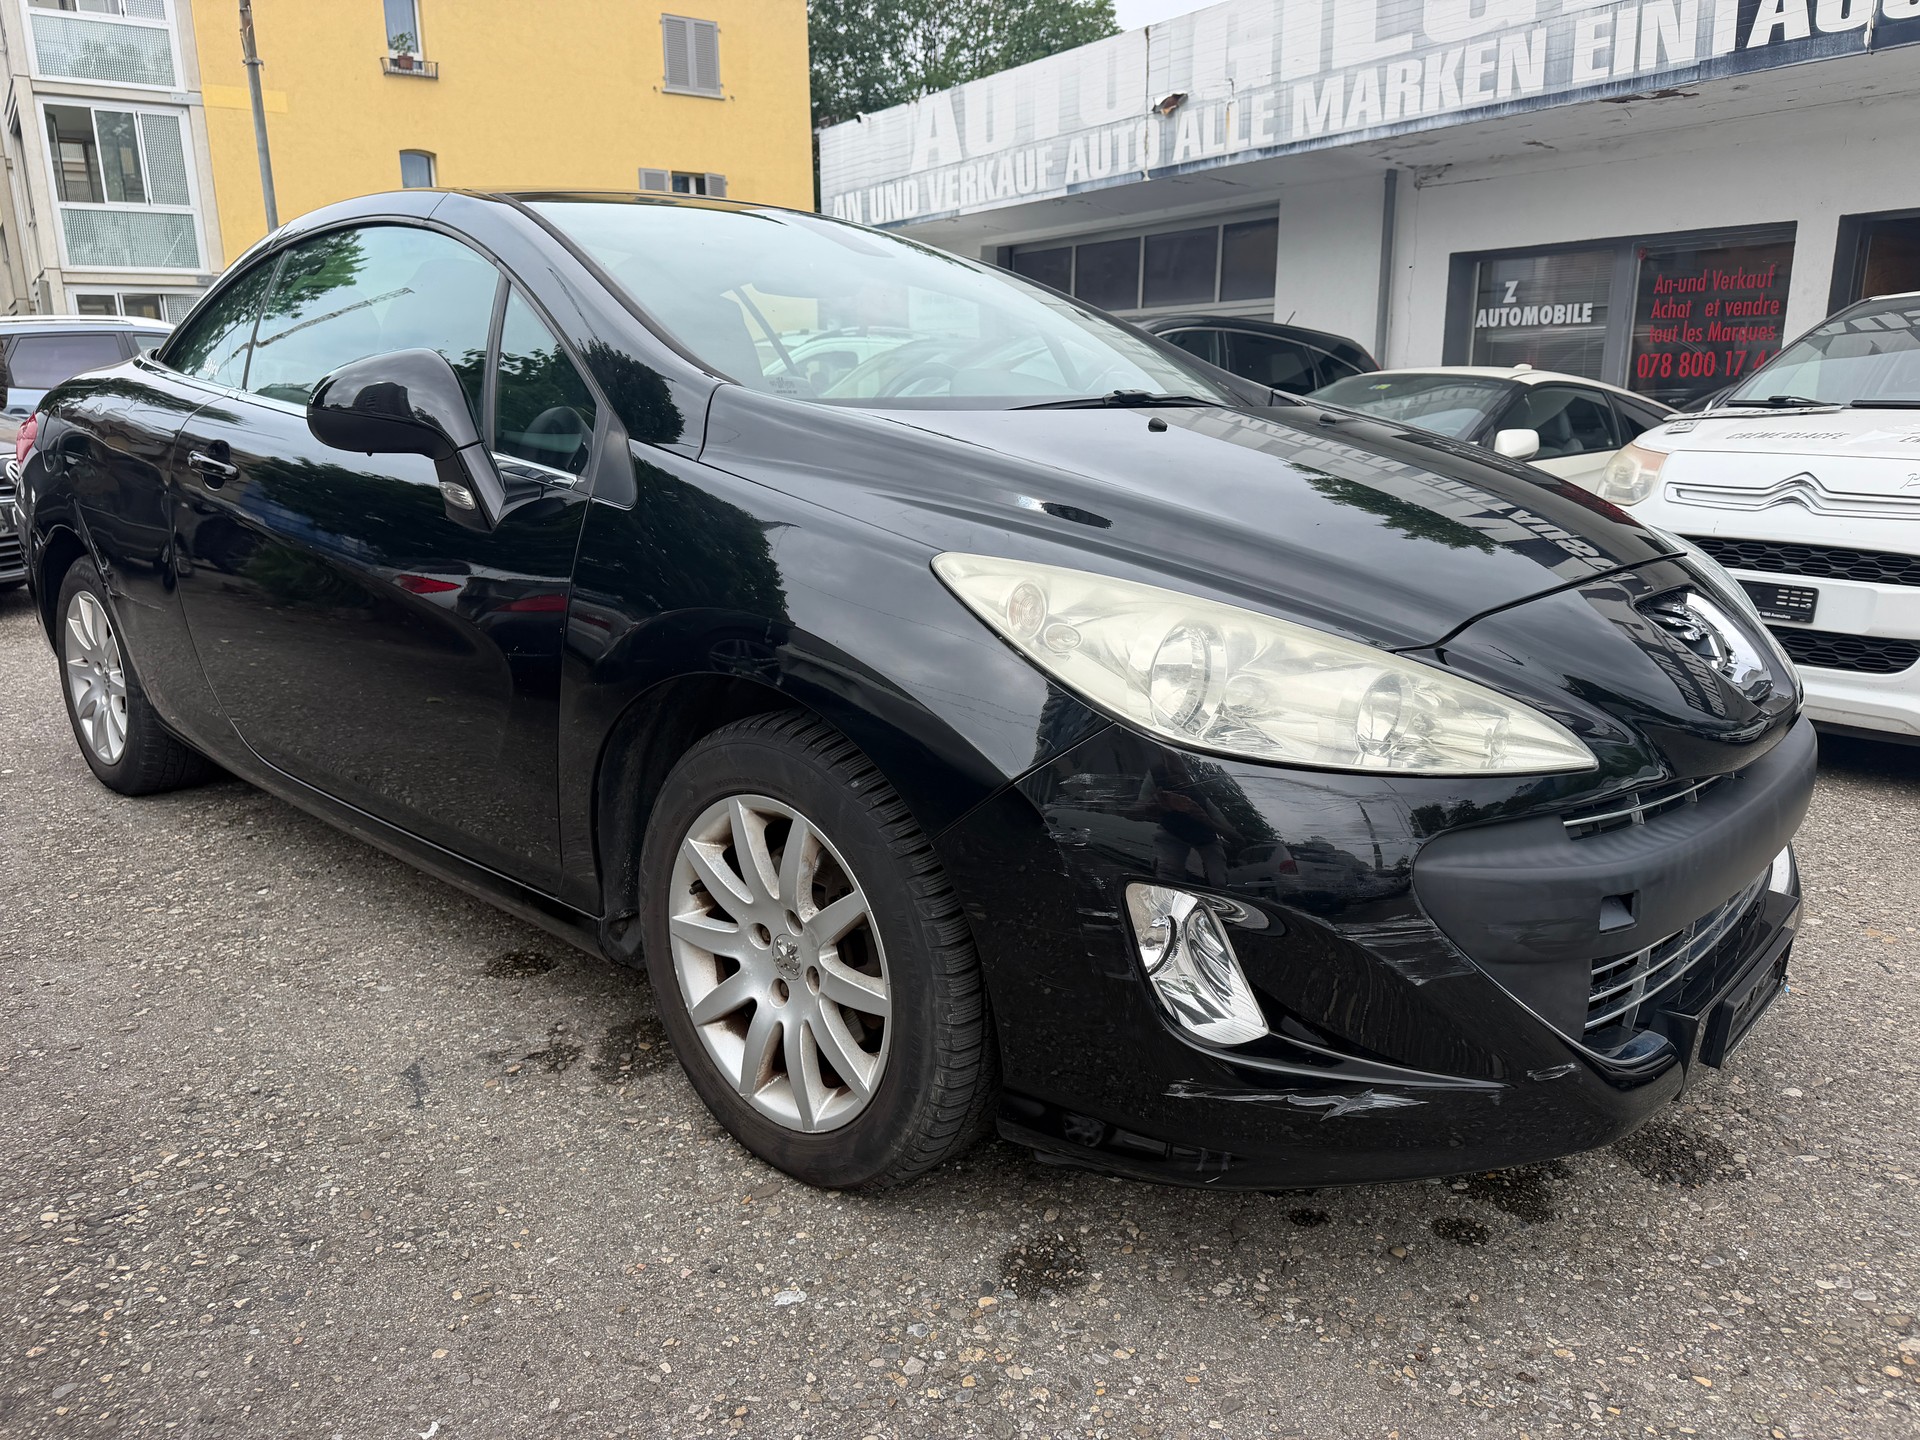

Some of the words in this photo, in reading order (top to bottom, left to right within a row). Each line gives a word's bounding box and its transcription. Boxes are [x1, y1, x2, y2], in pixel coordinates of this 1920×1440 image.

[832, 190, 863, 223] AN
[868, 178, 921, 226] UND
[925, 145, 1054, 211] VERKAUF
[1064, 117, 1161, 185] AUTO
[1172, 90, 1276, 163] ALLE
[1292, 24, 1547, 139] MARKEN
[1503, 280, 1518, 304] Z
[1653, 269, 1708, 294] An-und
[1712, 264, 1776, 290] Verkauf
[1475, 301, 1593, 329] AUTOMOBILE
[1651, 297, 1693, 319] Achat
[1704, 298, 1721, 317] et
[1725, 292, 1780, 317] vendre
[1649, 324, 1679, 343] tout
[1682, 320, 1703, 342] les
[1707, 320, 1776, 345] Marques
[1636, 351, 1673, 379] 078
[1678, 351, 1716, 378] 800
[1725, 351, 1748, 377] 17
